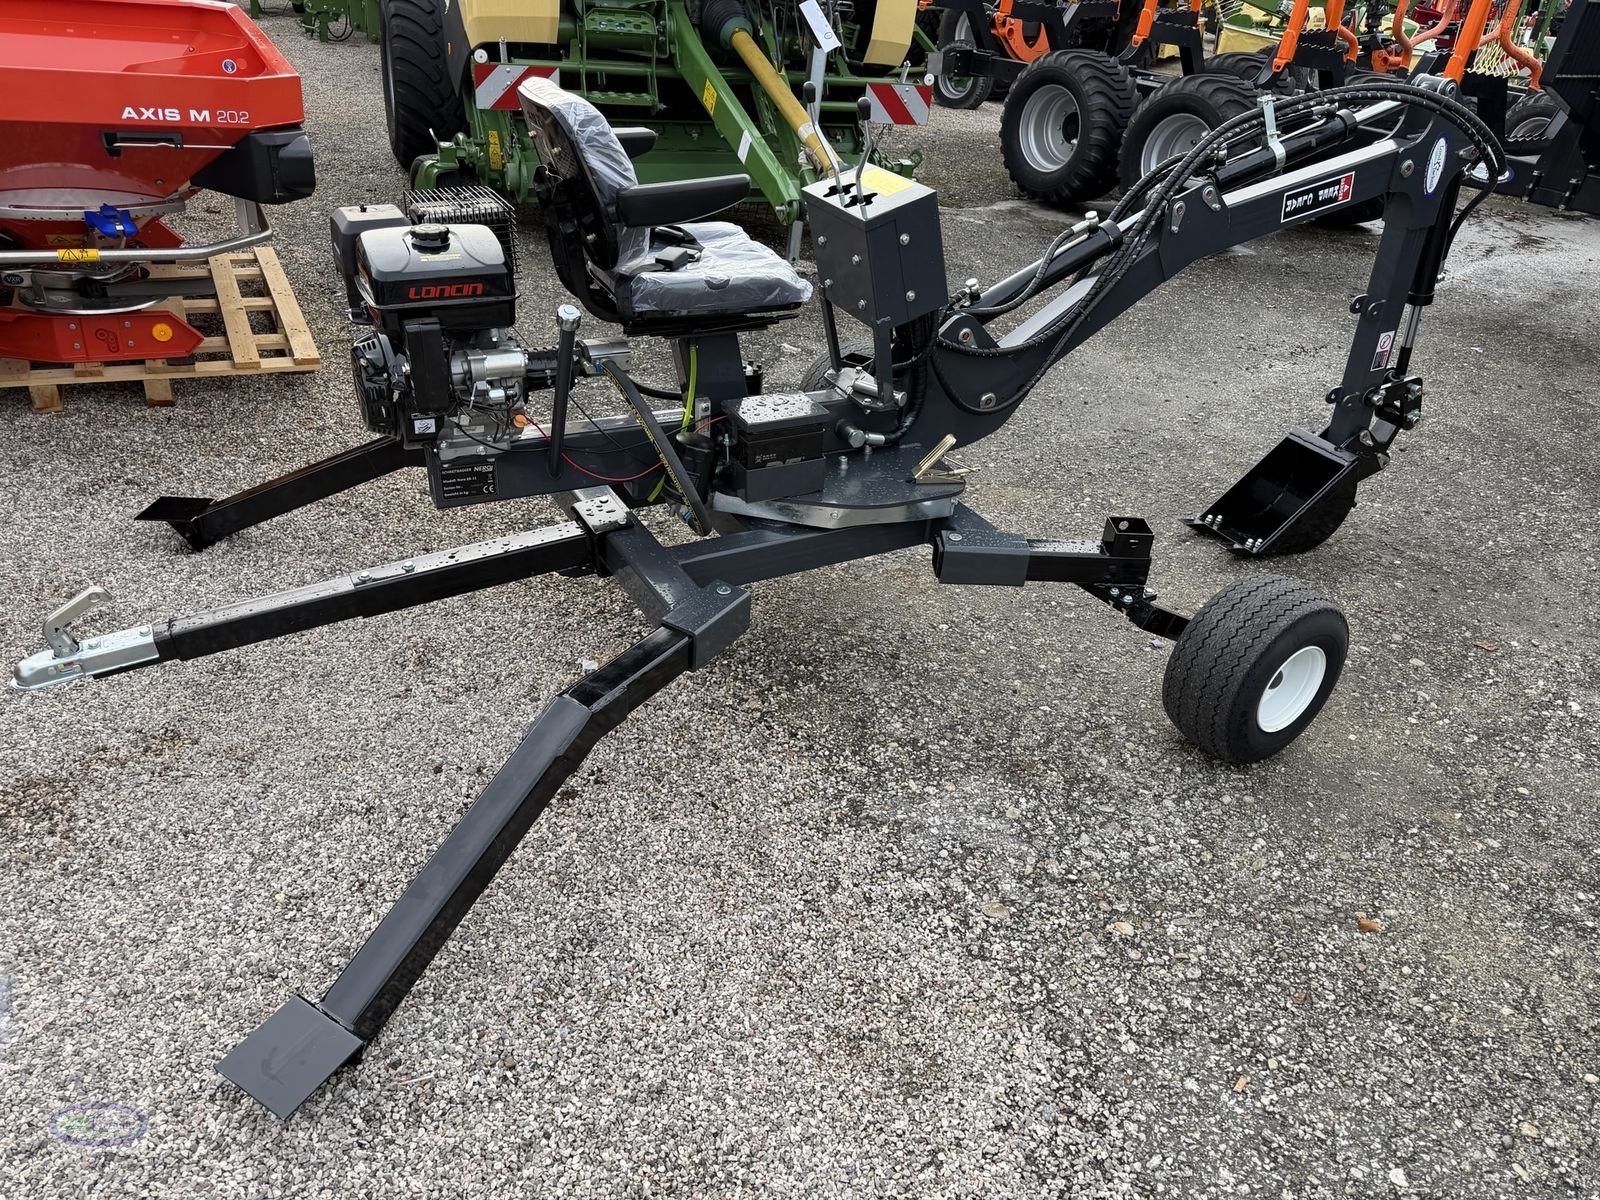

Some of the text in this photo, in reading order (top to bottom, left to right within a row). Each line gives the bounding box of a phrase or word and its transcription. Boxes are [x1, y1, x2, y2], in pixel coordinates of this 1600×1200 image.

[121, 106, 250, 124] AXIS M 20.2
[408, 282, 483, 299] LONCIN
